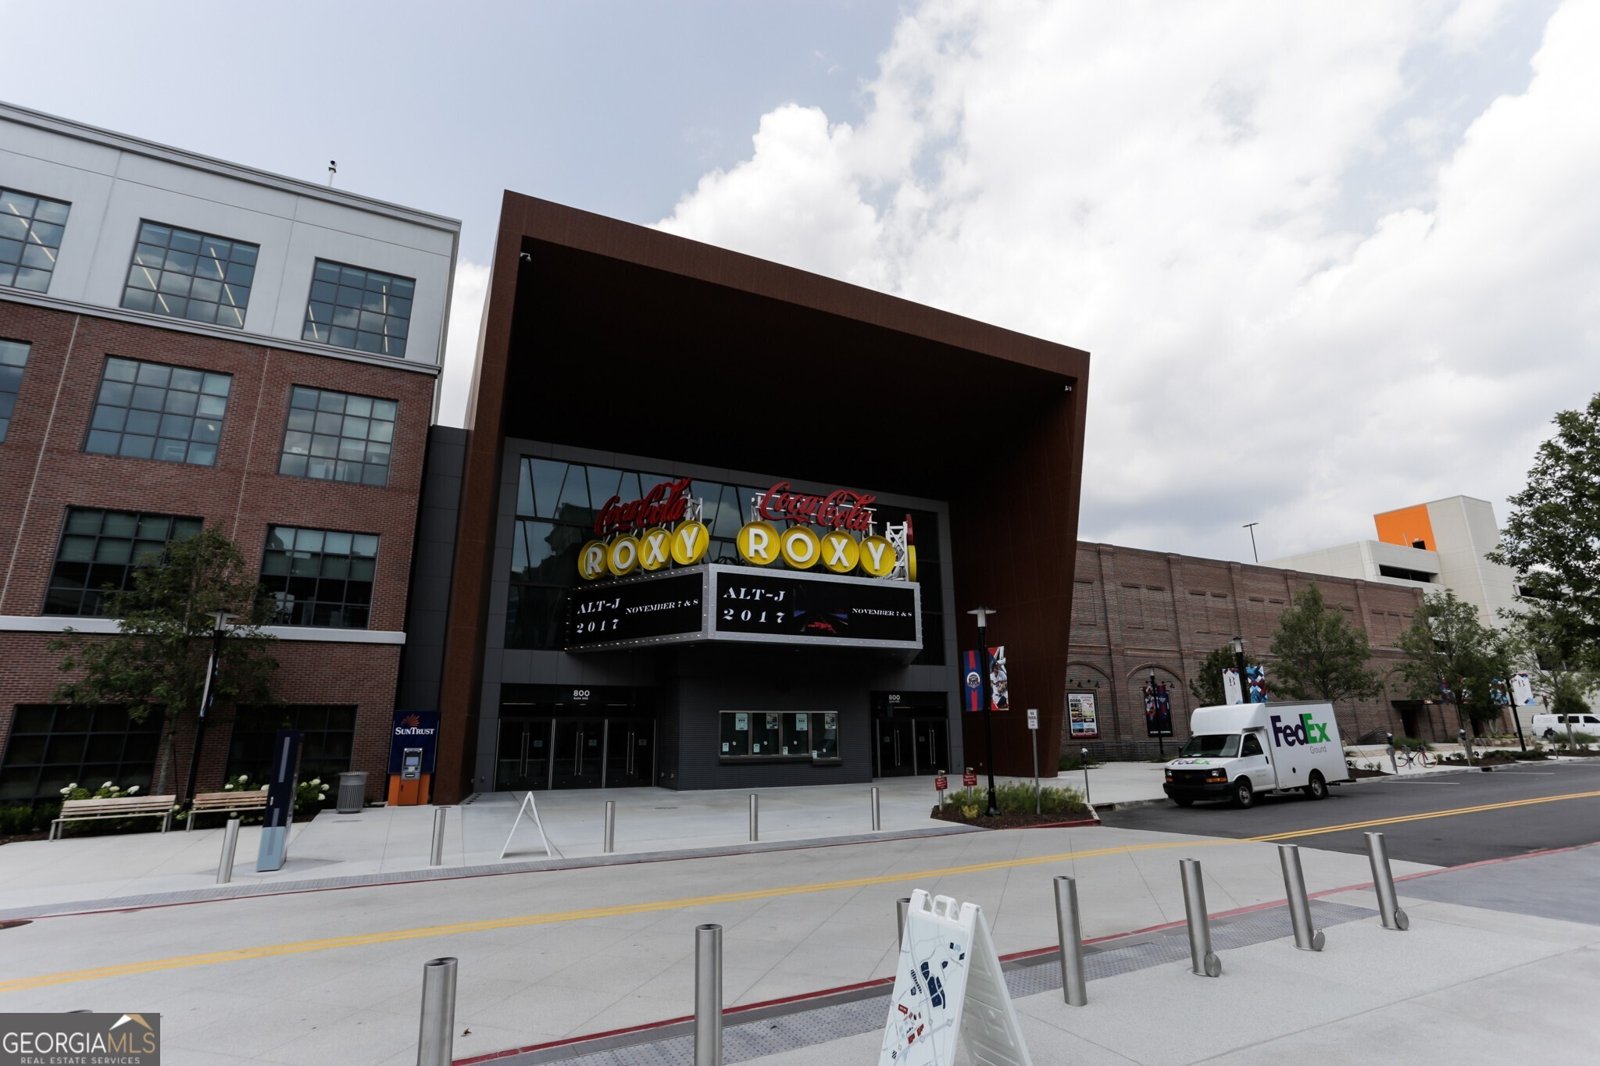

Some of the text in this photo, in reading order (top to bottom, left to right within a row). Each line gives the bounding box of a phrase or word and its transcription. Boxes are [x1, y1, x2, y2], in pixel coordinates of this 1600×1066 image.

[587, 526, 699, 575] ROXY
[748, 527, 886, 571] ROXY
[722, 586, 787, 602] ALT-J
[576, 598, 621, 615] ALT-J
[625, 601, 676, 615] NOVEMBER
[683, 599, 691, 607] &
[851, 607, 895, 617] NOVEMBER
[722, 608, 786, 624] 2017
[576, 618, 620, 634] 2017
[573, 689, 590, 697] 800
[1270, 713, 1332, 748] FedEx
[1309, 745, 1328, 755] Ground
